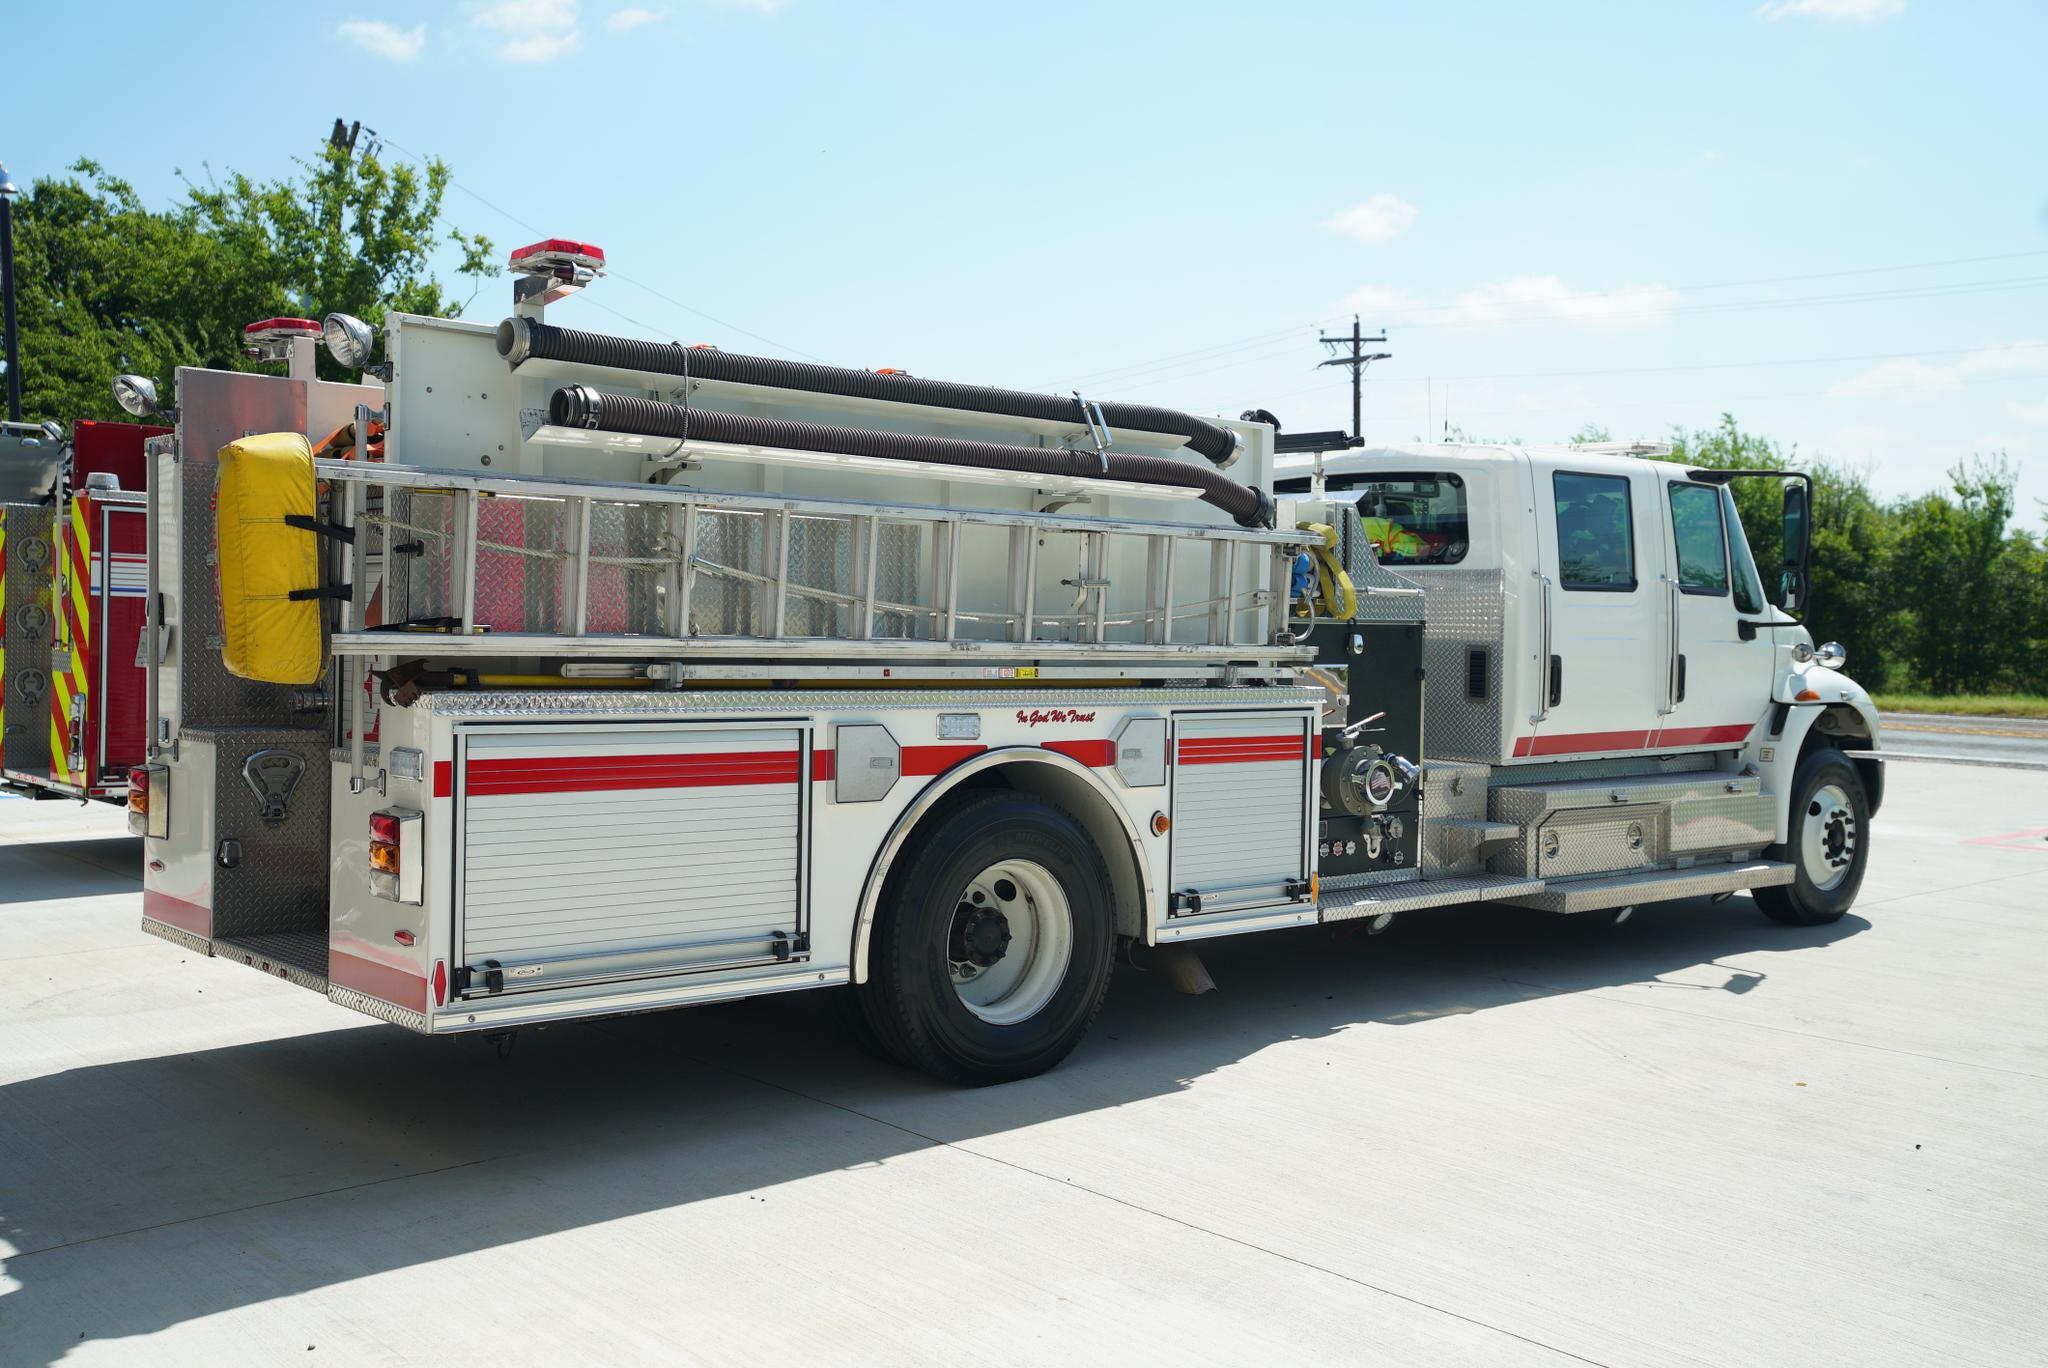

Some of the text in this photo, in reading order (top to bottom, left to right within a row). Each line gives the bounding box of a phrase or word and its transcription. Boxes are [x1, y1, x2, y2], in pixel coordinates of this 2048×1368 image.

[1016, 710, 1095, 727] In God We Trust
